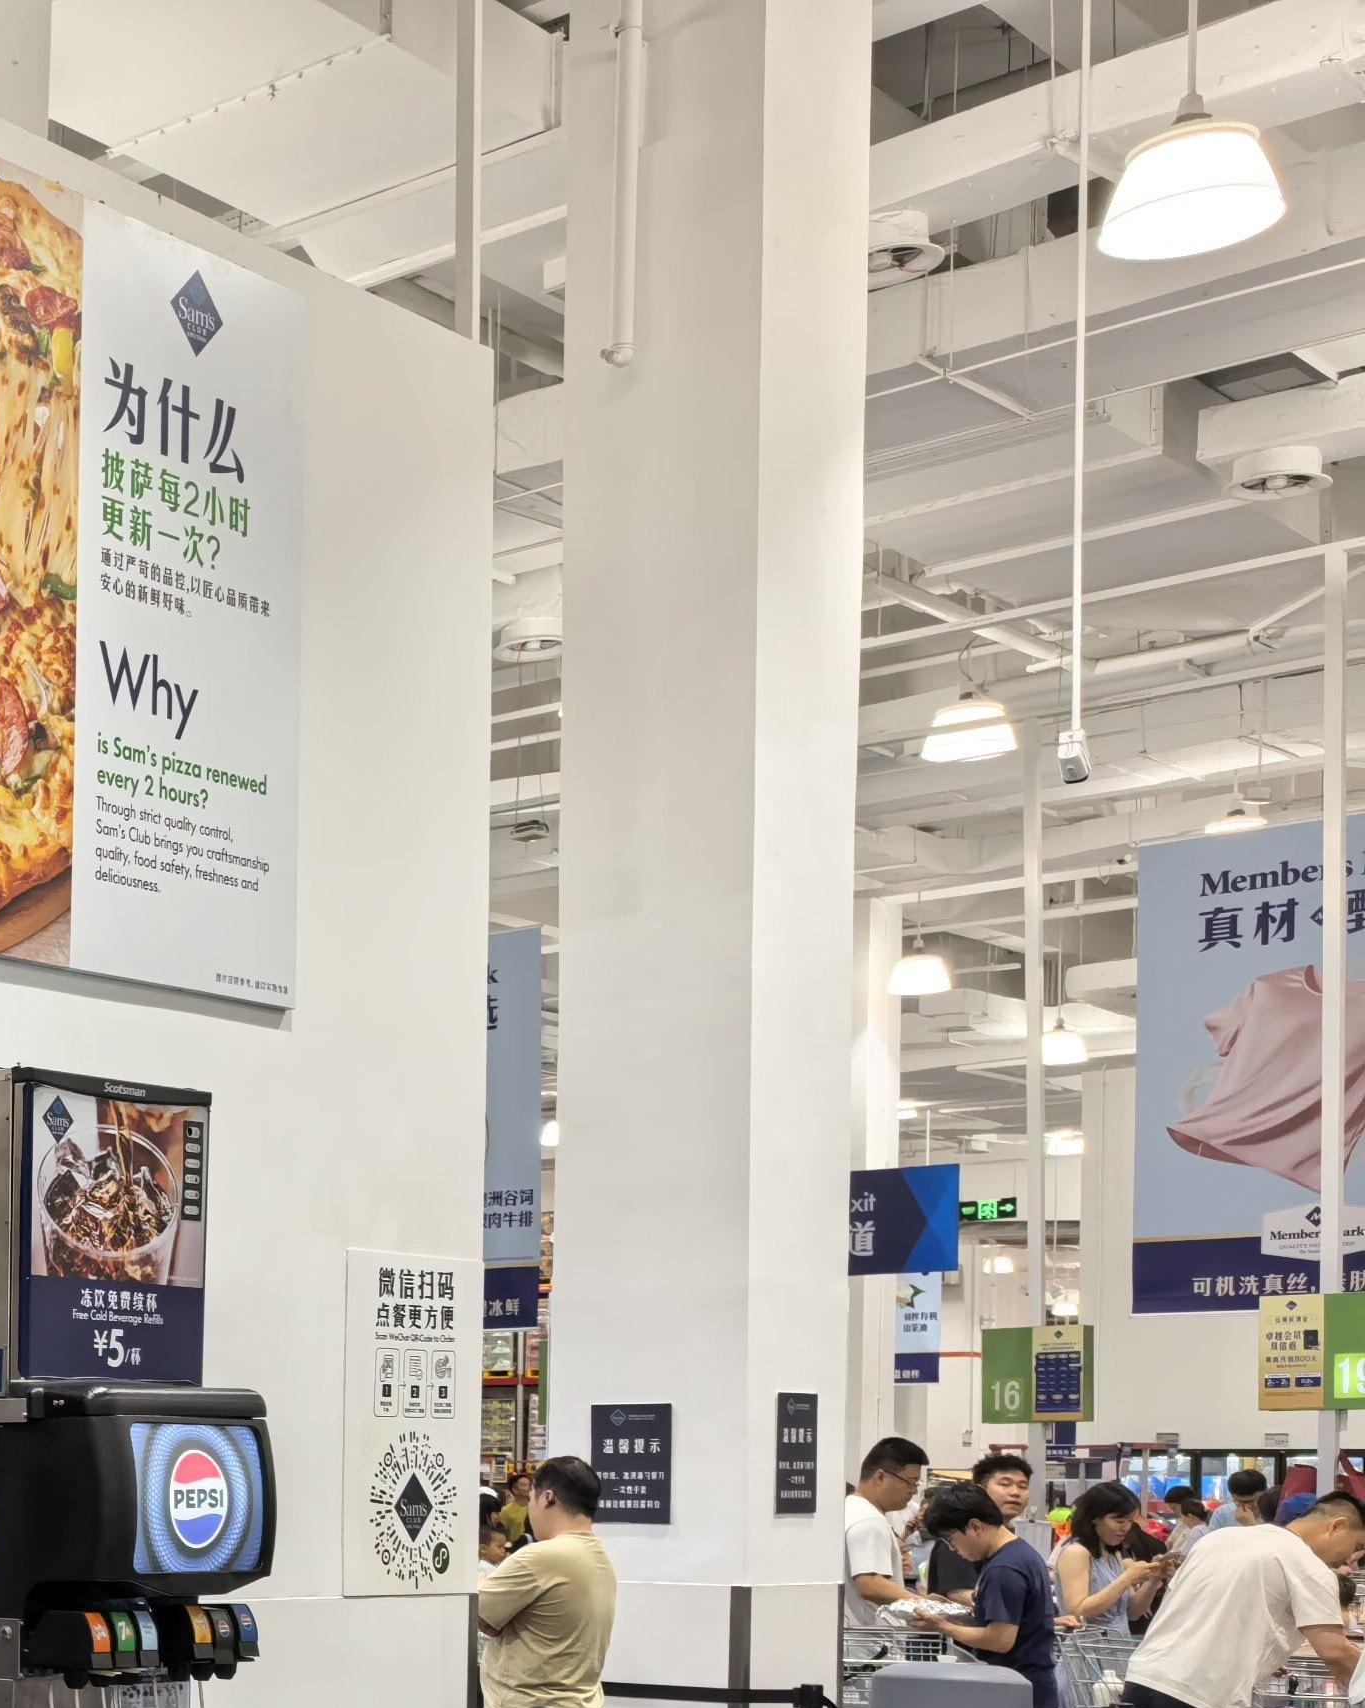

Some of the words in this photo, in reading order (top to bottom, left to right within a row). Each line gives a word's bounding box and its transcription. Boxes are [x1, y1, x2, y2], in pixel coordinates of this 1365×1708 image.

[178, 296, 215, 331] Sam's
[103, 356, 244, 483] 为什么
[102, 448, 250, 537] 披萨每2小时
[99, 640, 199, 740] Why
[113, 736, 157, 767] Sam's
[162, 751, 201, 779] pizza
[207, 768, 267, 795] renewed
[97, 769, 139, 798] every
[145, 775, 153, 796] 2
[159, 778, 208, 809] hours?
[96, 796, 136, 820] Through
[139, 808, 161, 825] strict
[164, 816, 196, 836] quality
[129, 829, 151, 846] Club
[154, 836, 183, 858] brings
[207, 846, 269, 872] craftsmanship
[95, 866, 161, 893] deliciousness.
[134, 852, 156, 869] food
[195, 865, 238, 888] freshness
[104, 1082, 146, 1097] Scotsman
[484, 1189, 534, 1207] 洲谷饲
[850, 1192, 876, 1213] xit
[81, 1288, 157, 1310] 冻饮免费续杯
[378, 1267, 454, 1301] 微信扫码
[72, 1309, 88, 1320] Free
[91, 1310, 107, 1321] Cold
[109, 1311, 142, 1325] Beverage
[144, 1313, 164, 1324] Refills
[376, 1303, 454, 1330] 点餐更方便
[991, 1380, 1020, 1412] 16
[174, 1490, 224, 1509] PEPSI
